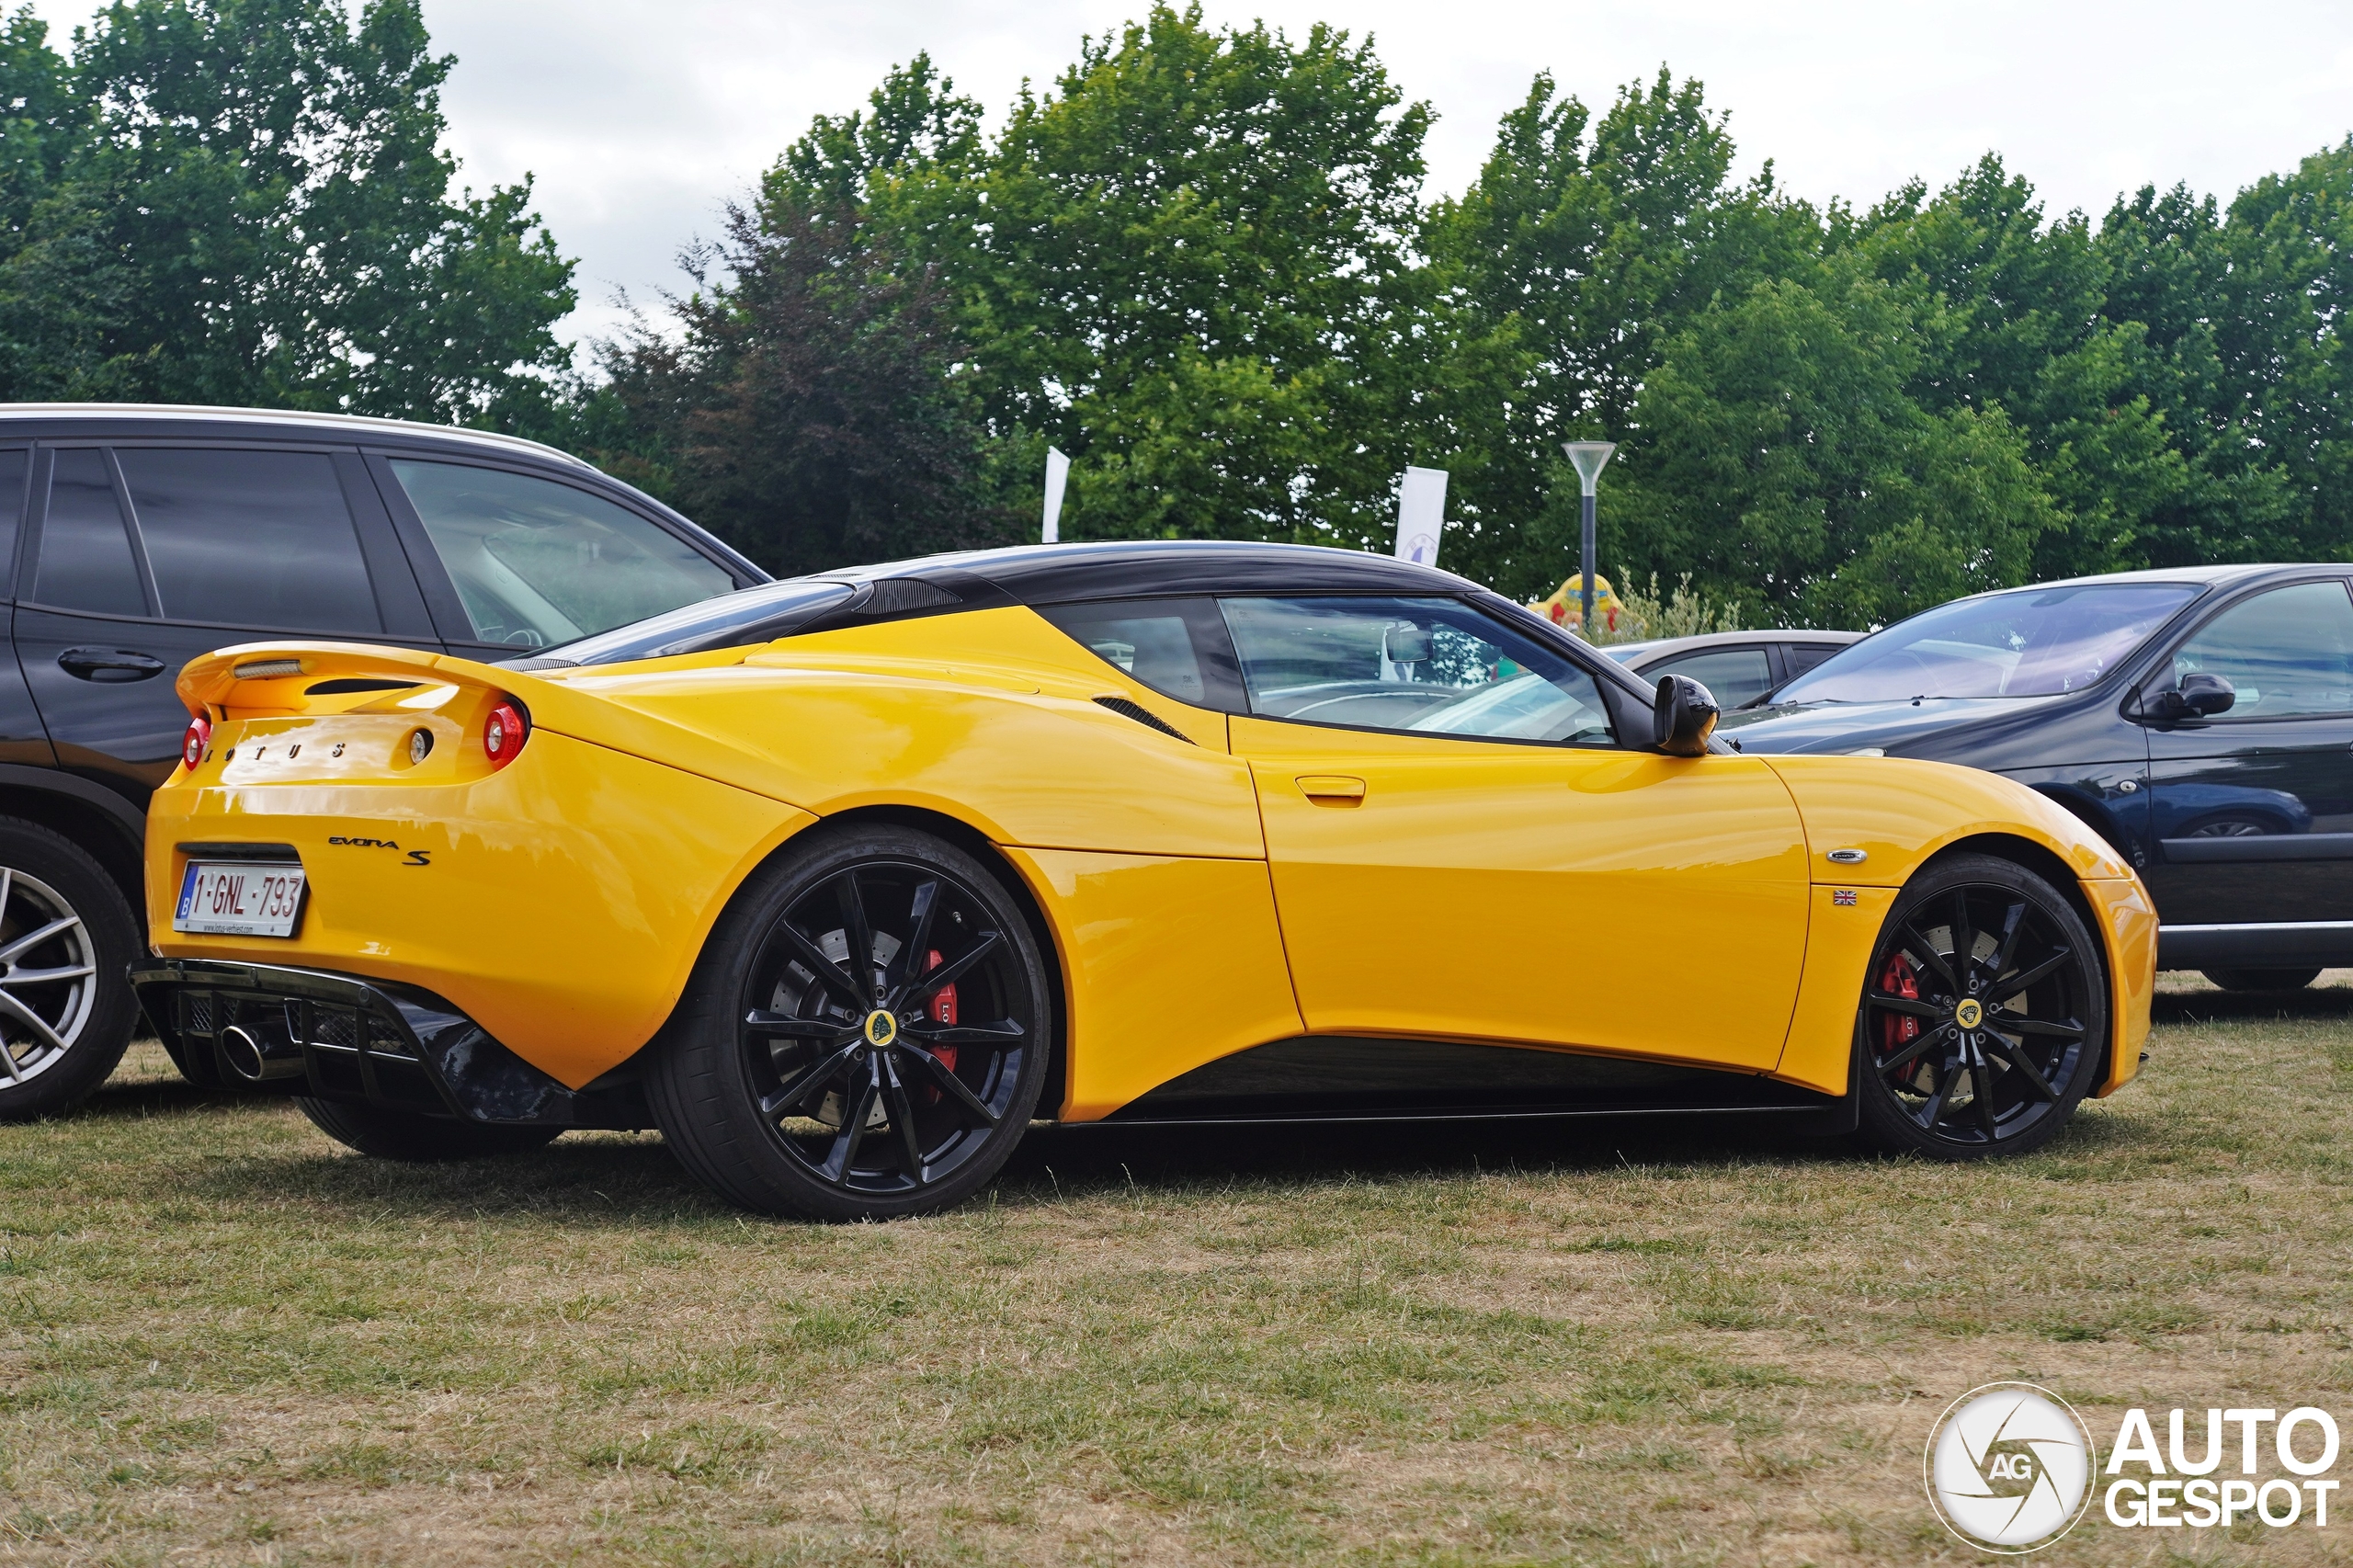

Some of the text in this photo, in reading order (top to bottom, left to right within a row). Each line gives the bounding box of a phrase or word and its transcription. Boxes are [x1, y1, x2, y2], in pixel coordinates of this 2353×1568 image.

[203, 742, 347, 764] LOTUS
[328, 836, 431, 866] EVORA S
[180, 897, 191, 916] B
[203, 923, 254, 934] www.lotus-verhiest.com
[1960, 1006, 1978, 1017] LOTUS
